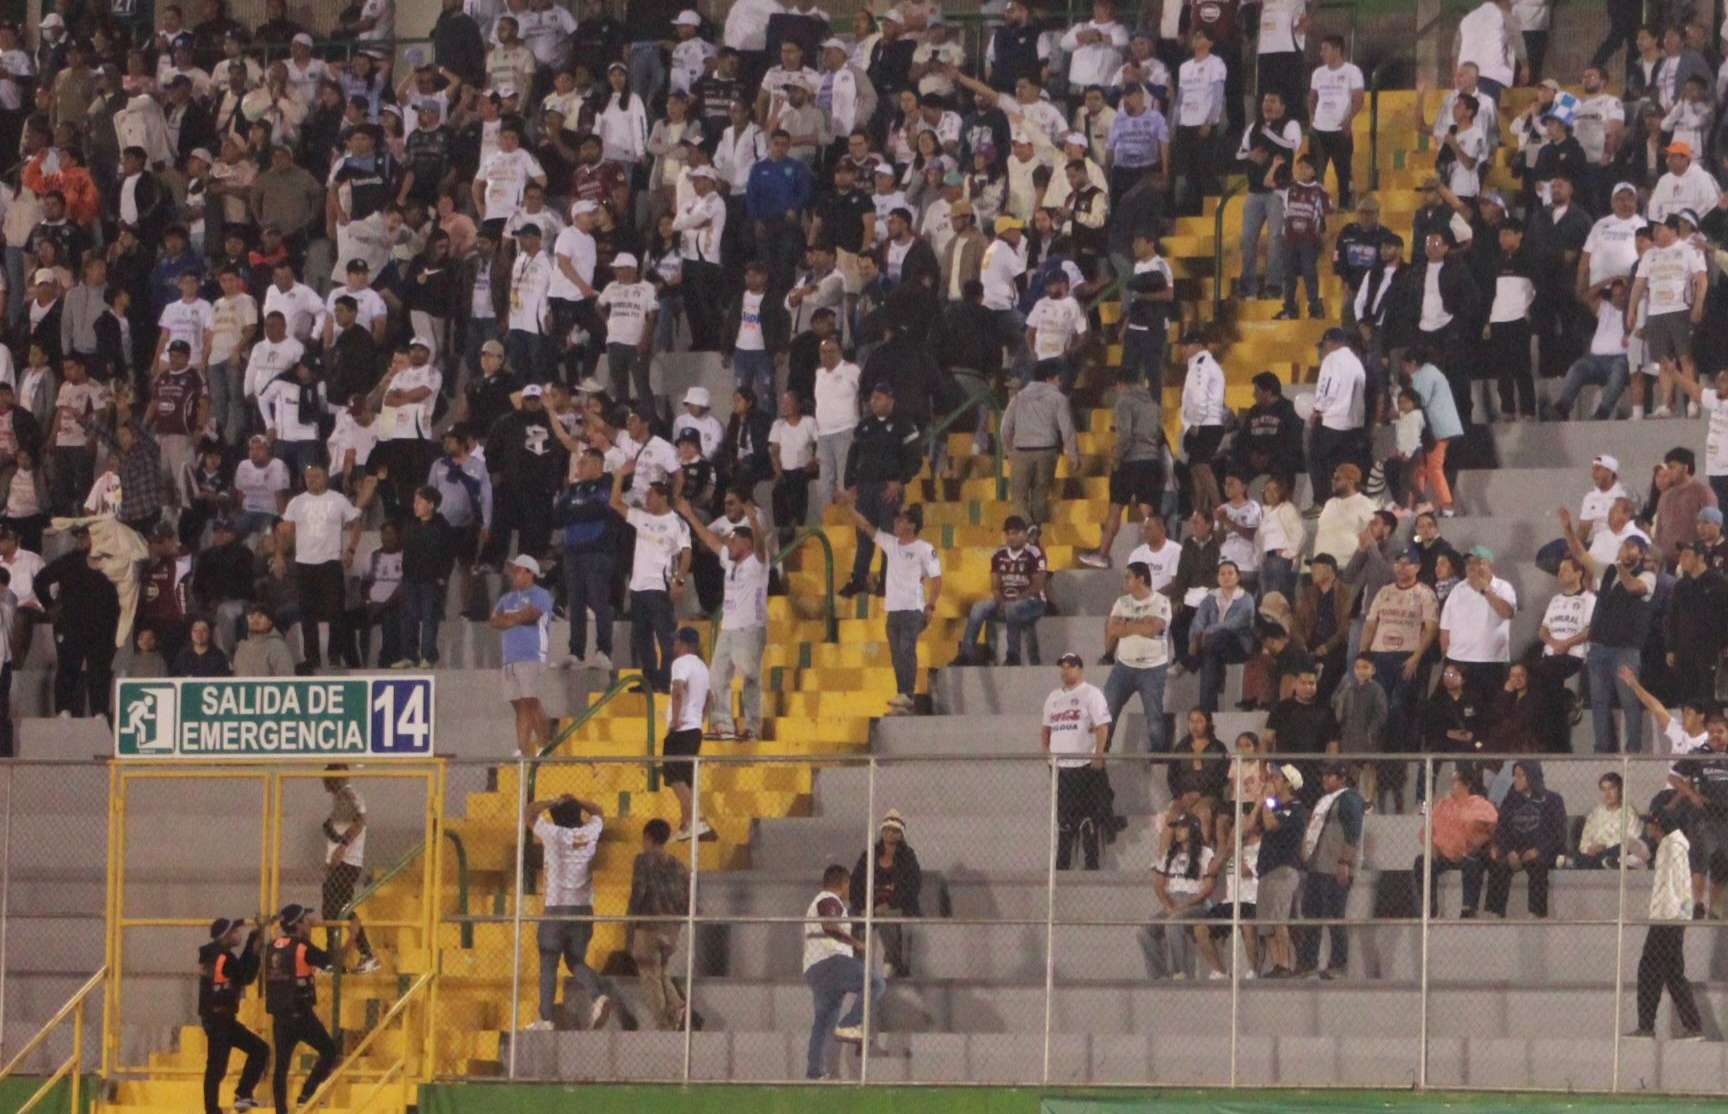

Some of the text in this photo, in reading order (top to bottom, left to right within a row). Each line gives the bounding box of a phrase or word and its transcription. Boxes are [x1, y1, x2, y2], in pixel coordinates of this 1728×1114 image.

[201, 684, 345, 716] SALIDA DE
[373, 684, 429, 748] 14
[182, 719, 365, 751] EMERGENCIA
